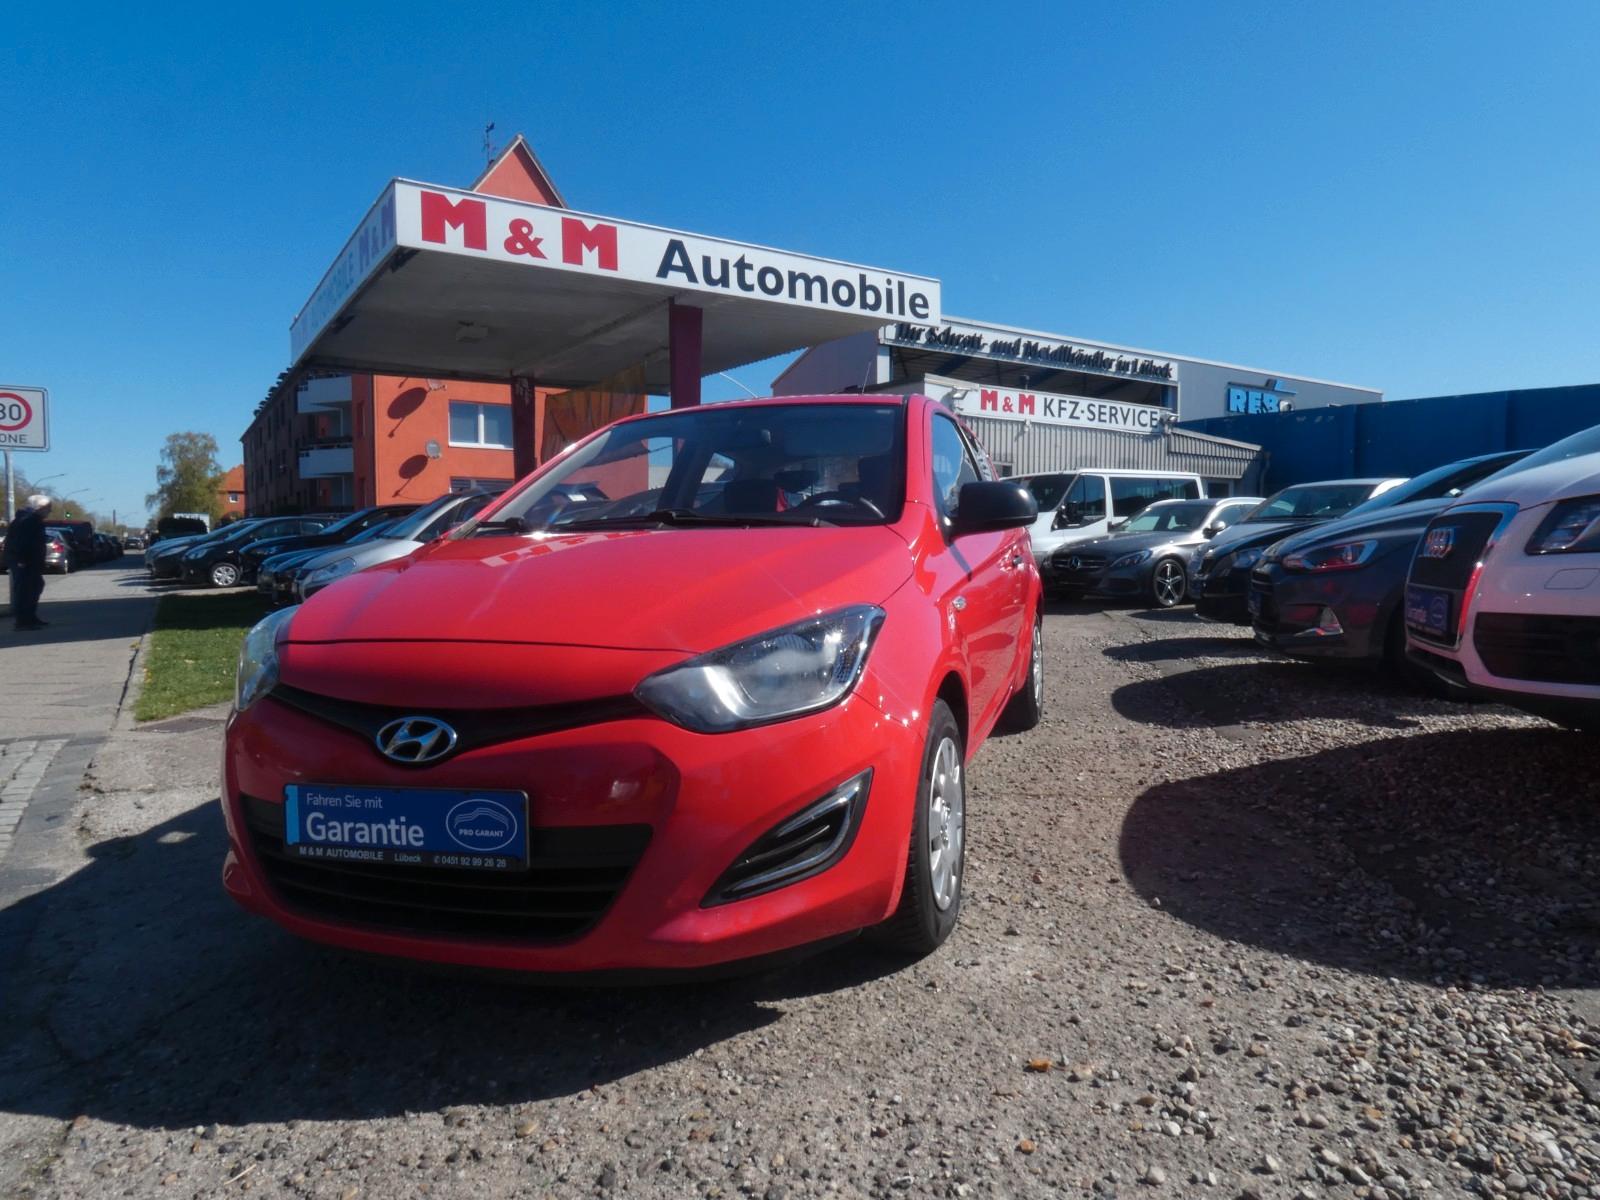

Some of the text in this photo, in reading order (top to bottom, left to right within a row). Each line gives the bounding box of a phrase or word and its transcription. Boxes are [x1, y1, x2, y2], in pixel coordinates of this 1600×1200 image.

[421, 191, 930, 320] M & M Automobile
[990, 338, 1021, 356] und
[980, 388, 998, 412] M
[1002, 398, 1014, 413] &
[1018, 393, 1036, 416] M
[0, 433, 28, 444] ONE
[306, 793, 383, 809] Fahren Sie mit
[306, 811, 425, 847] Garantie
[479, 829, 505, 838] GARANT
[299, 846, 307, 855] M
[315, 847, 323, 857] M
[326, 848, 384, 861] AUTOMOBILE
